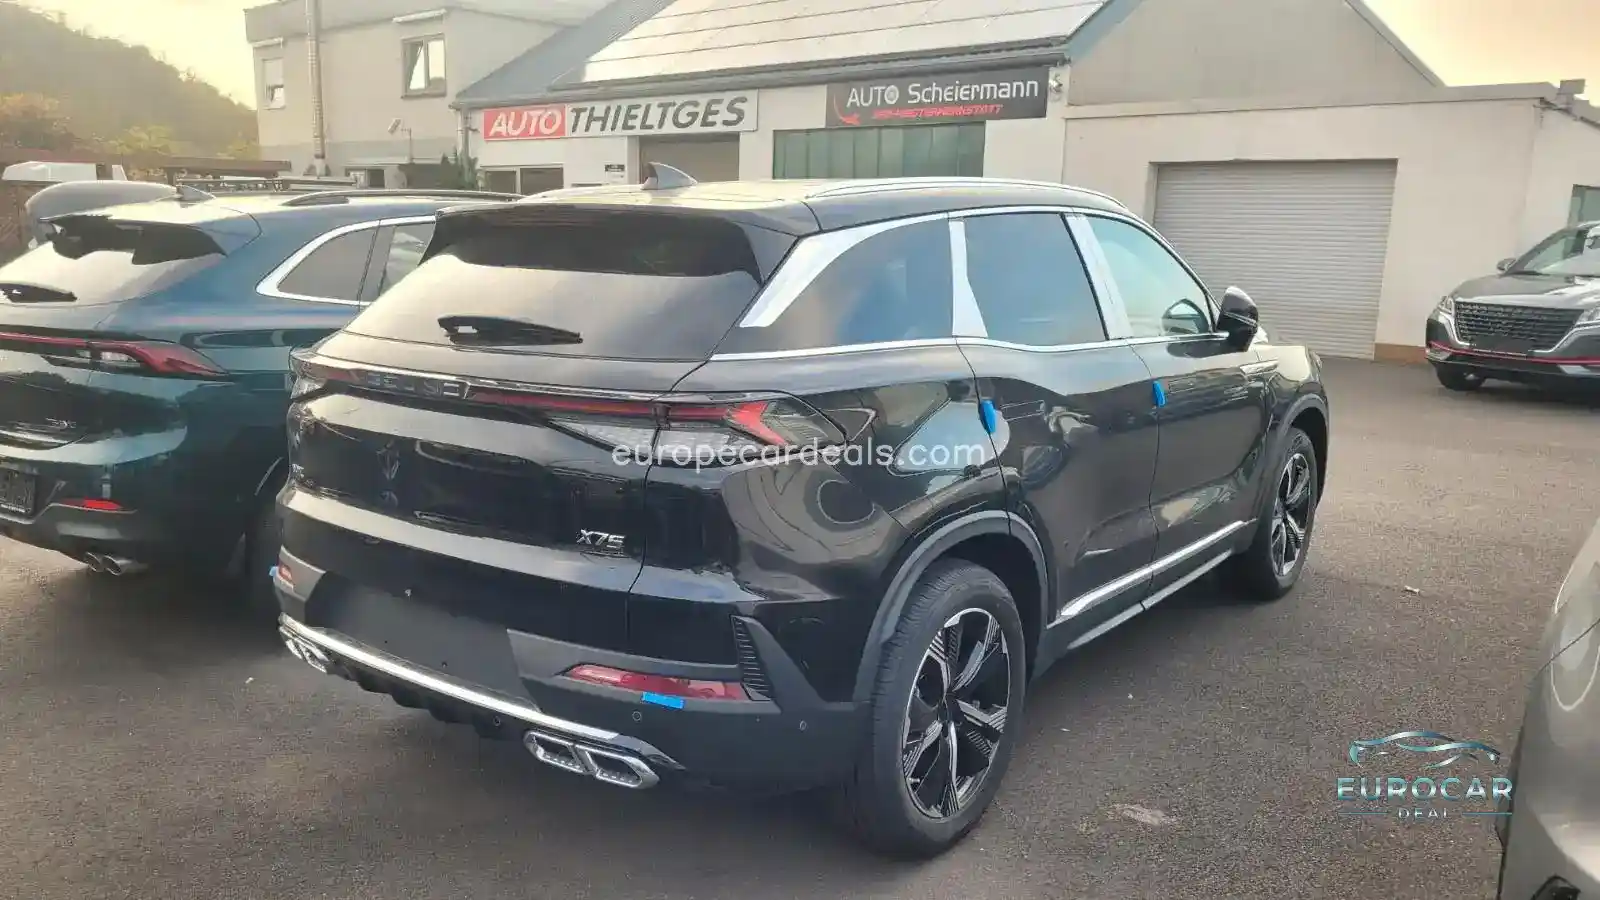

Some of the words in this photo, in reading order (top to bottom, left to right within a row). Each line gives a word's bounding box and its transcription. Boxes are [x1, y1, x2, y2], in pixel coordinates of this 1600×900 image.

[848, 85, 900, 108] AUTO
[907, 80, 1038, 104] Scheiermann
[489, 109, 562, 136] AUTO
[570, 97, 747, 133] THIELTGES
